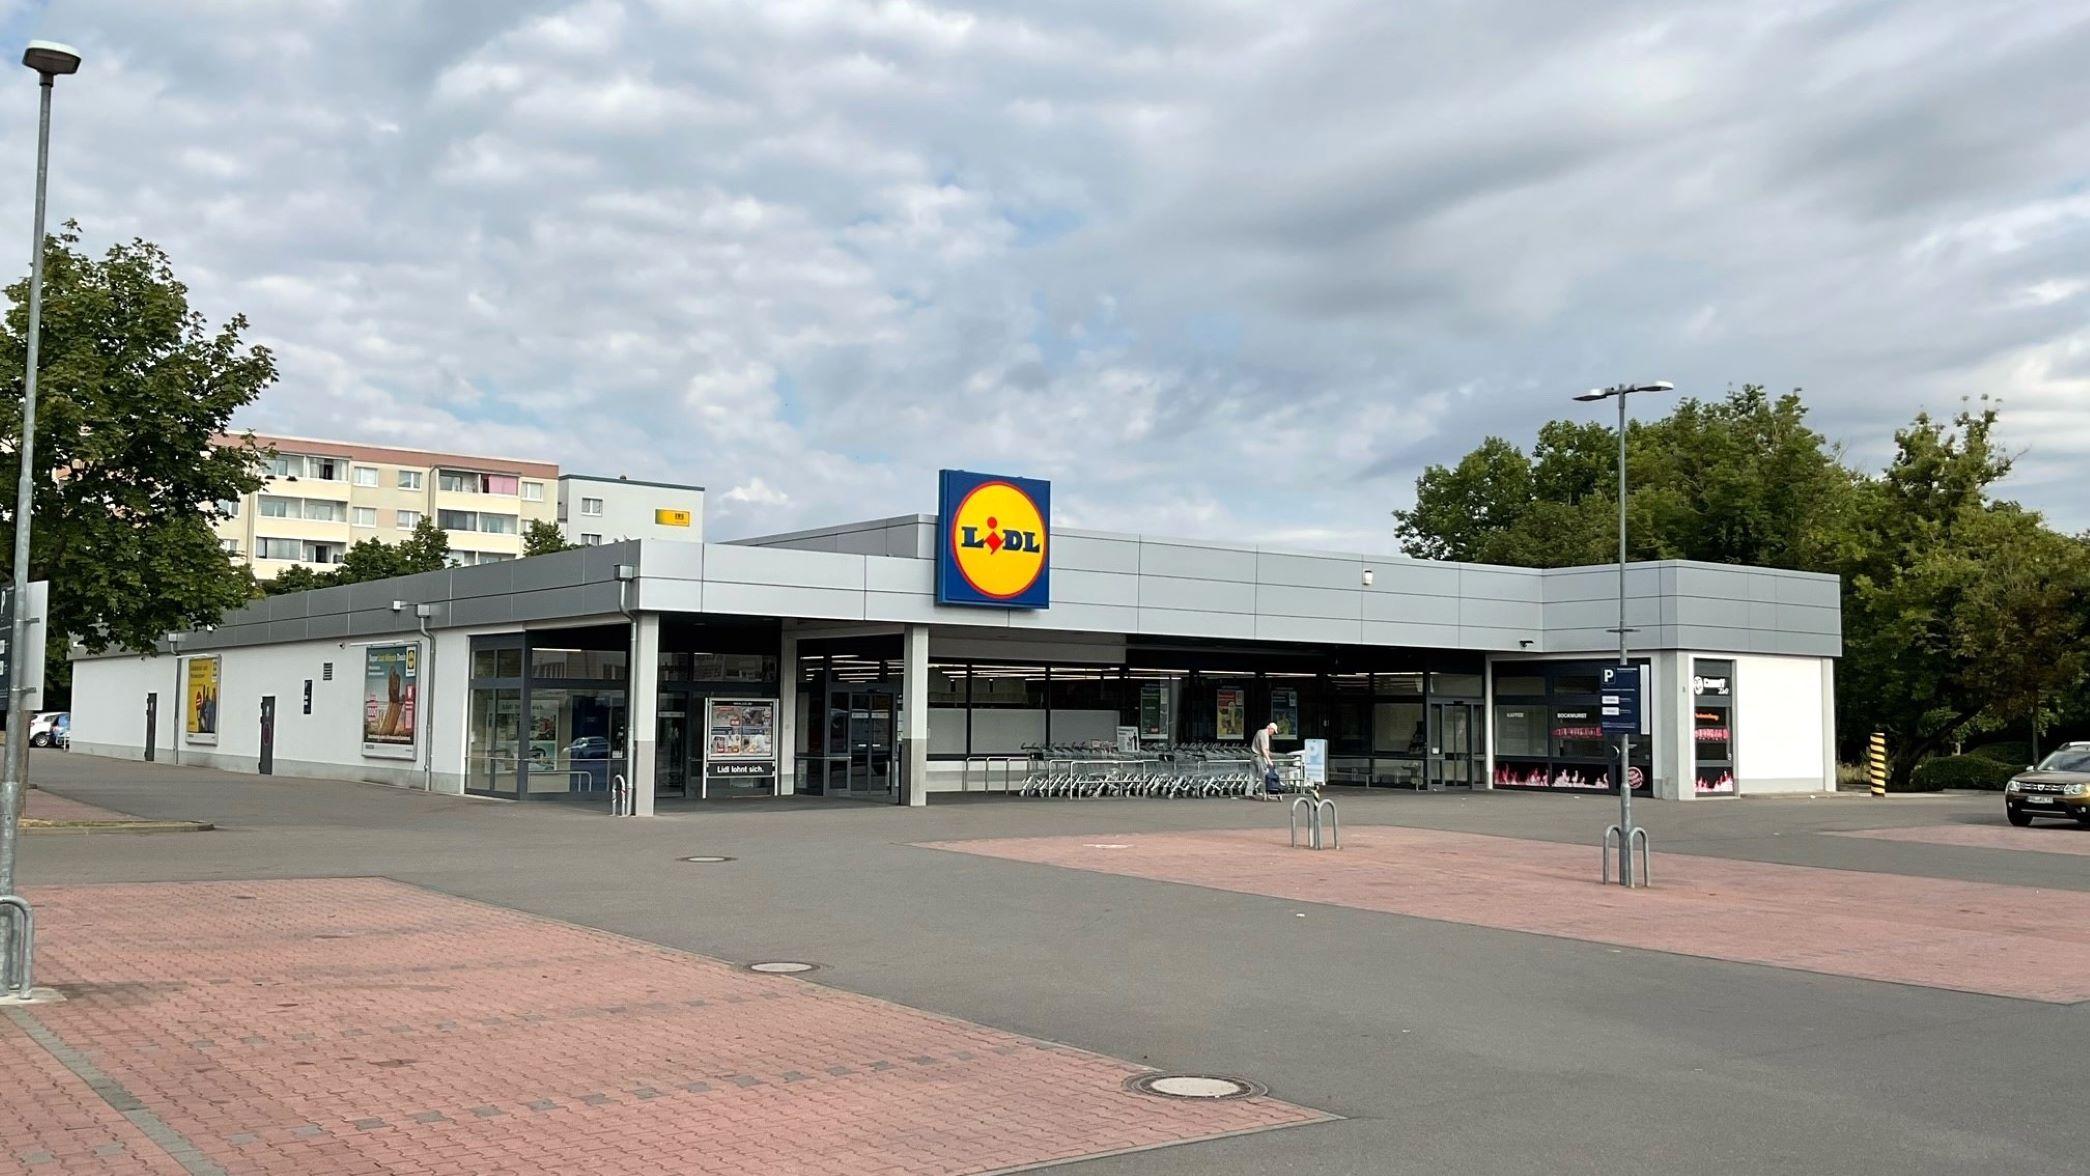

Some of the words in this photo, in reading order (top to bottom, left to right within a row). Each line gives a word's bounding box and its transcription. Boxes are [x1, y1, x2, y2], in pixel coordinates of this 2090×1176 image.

[961, 516, 1040, 555] LIDL
[1604, 669, 1614, 682] P
[717, 765, 729, 773] Lidl
[731, 765, 747, 773] lohnt
